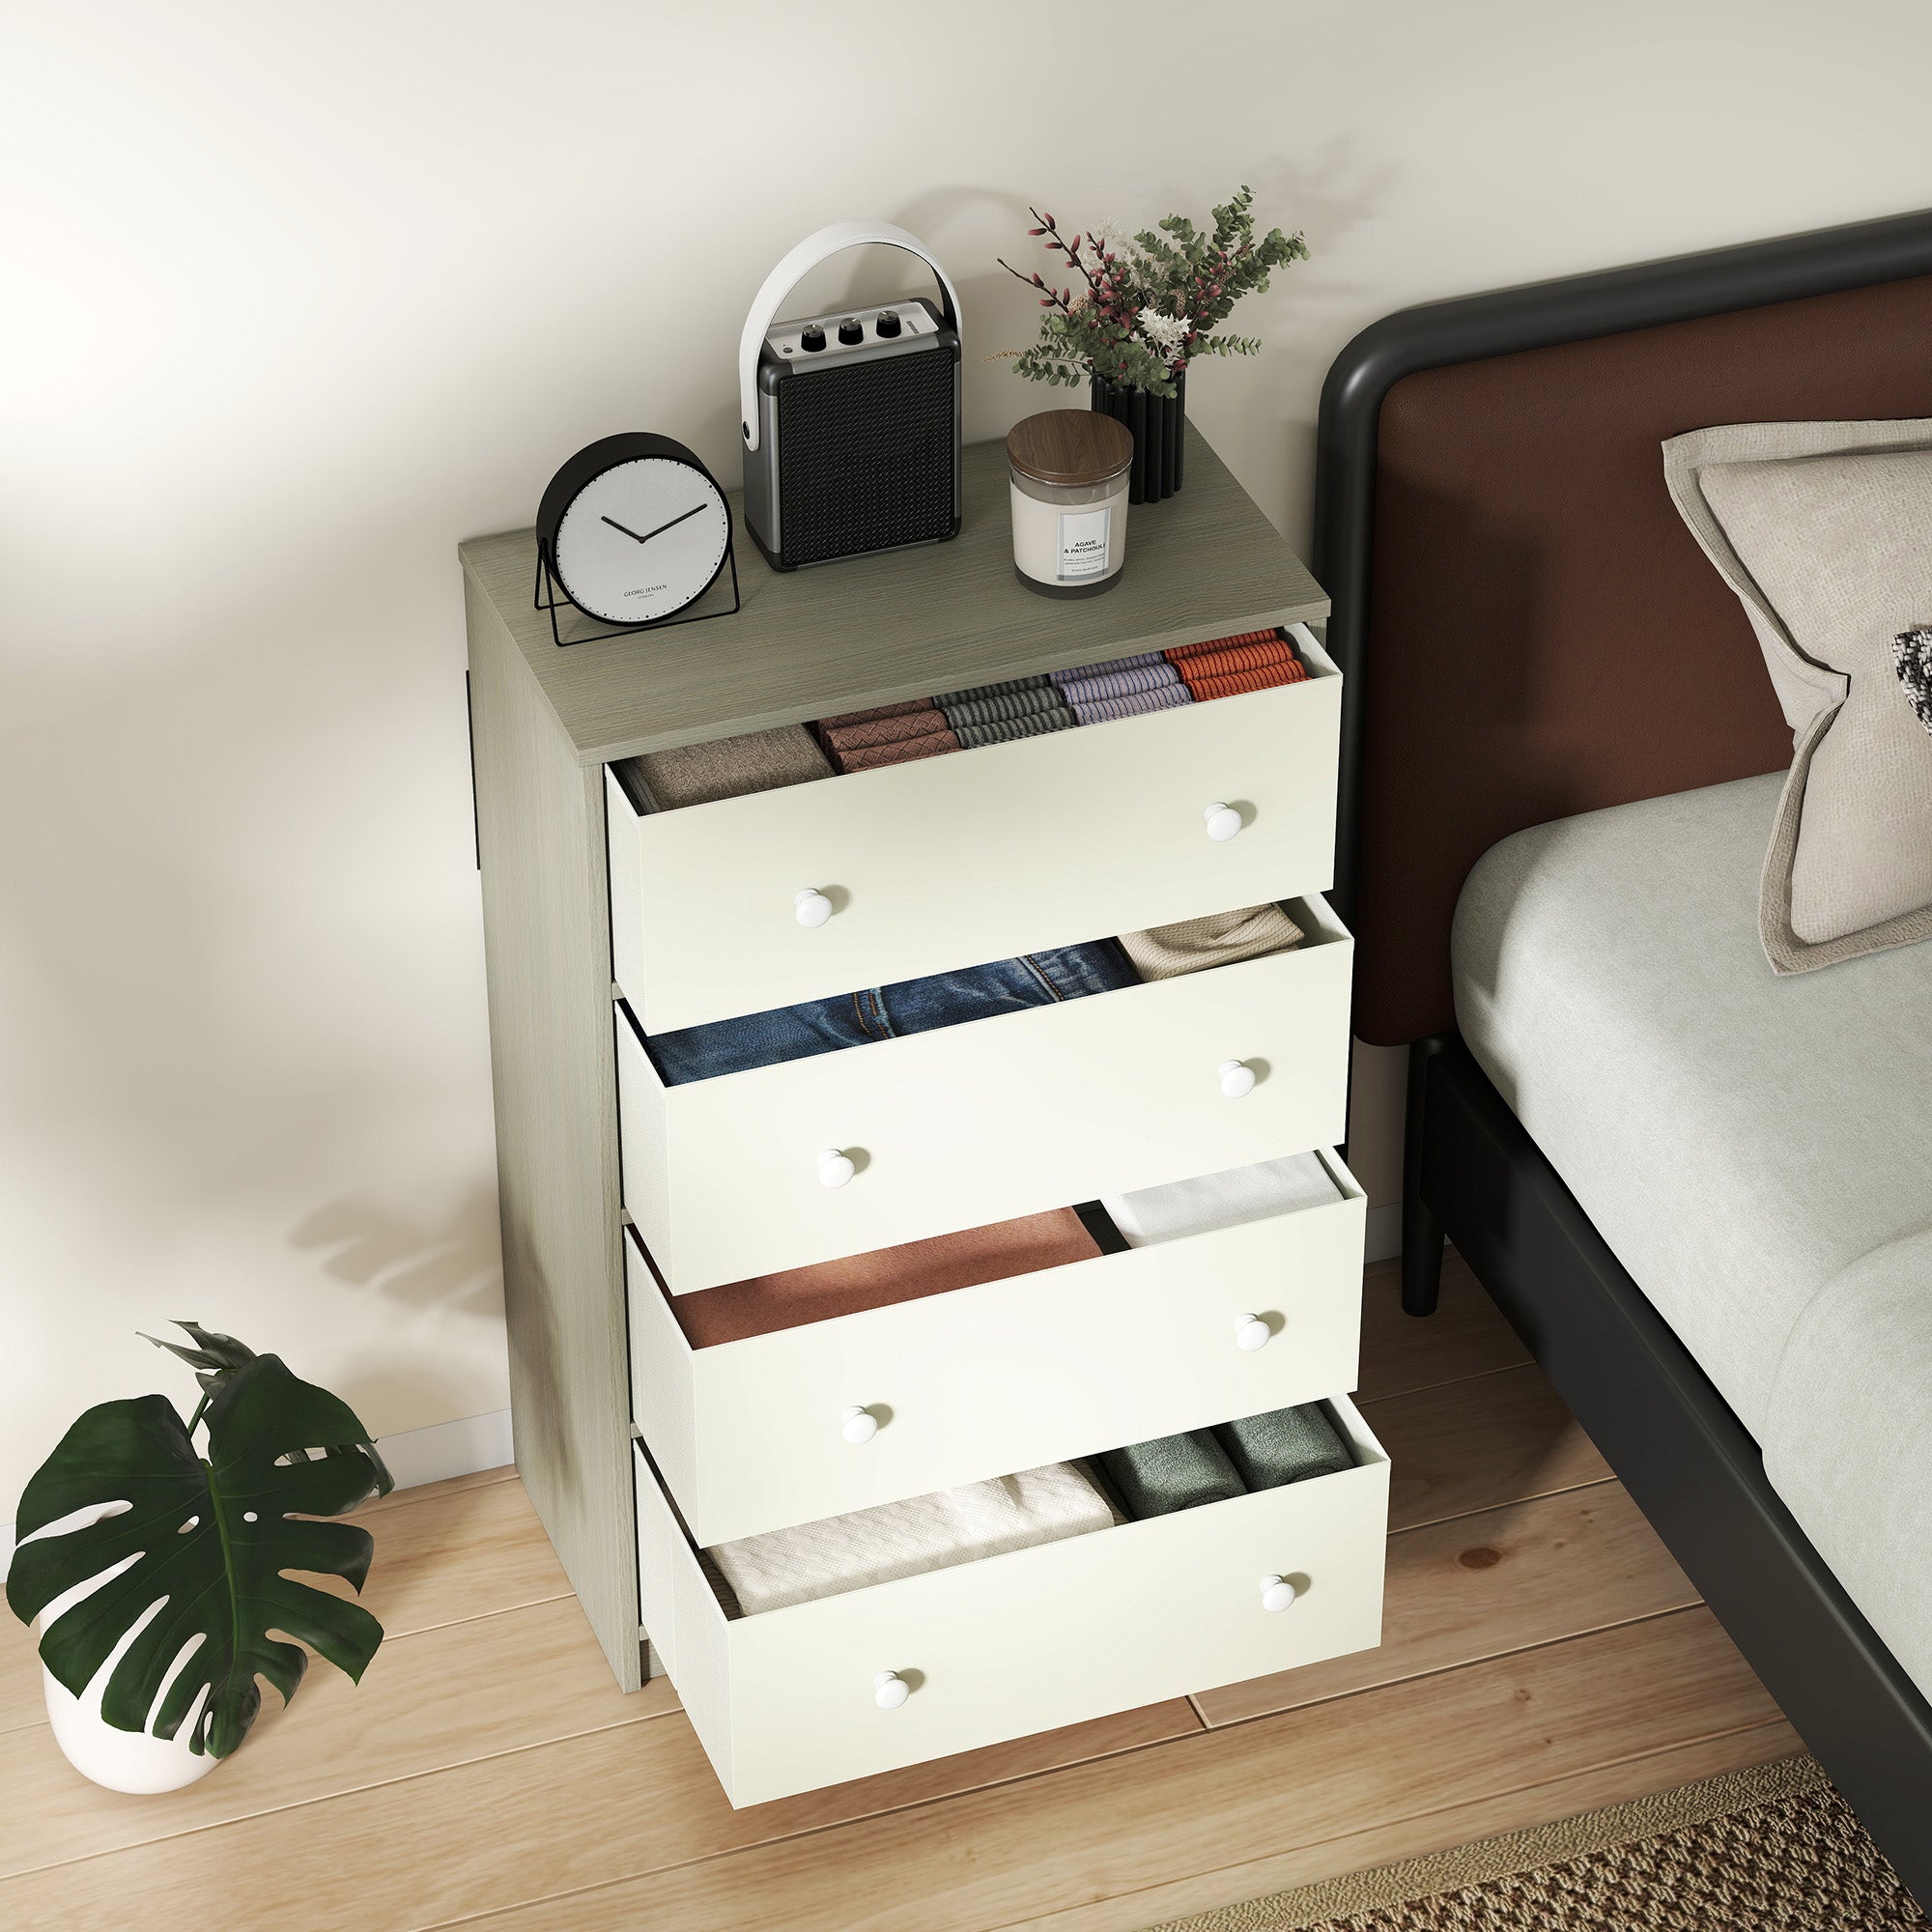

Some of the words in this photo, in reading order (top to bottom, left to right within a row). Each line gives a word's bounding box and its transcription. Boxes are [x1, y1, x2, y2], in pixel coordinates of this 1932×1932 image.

[1070, 543, 1106, 554] PATCHOULI
[623, 588, 644, 597] GEORG
[645, 583, 668, 593] JENSEN
